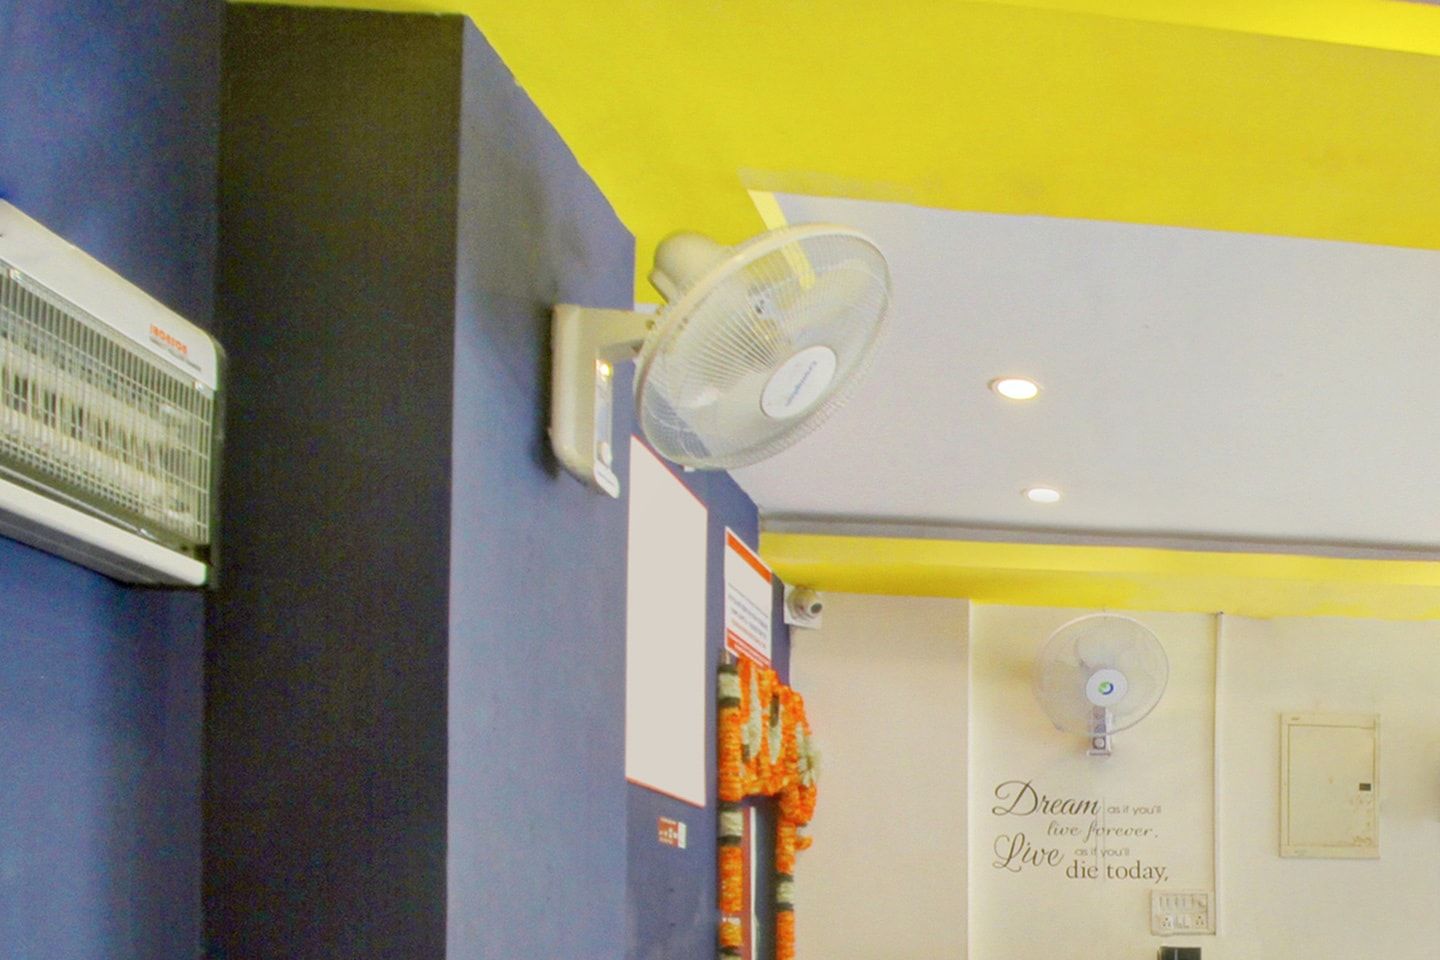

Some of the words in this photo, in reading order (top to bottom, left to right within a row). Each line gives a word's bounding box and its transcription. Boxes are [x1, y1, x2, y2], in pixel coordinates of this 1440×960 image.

[991, 779, 1100, 817] Dream
[1106, 804, 1120, 815] as
[1122, 803, 1129, 815] if
[1047, 819, 1082, 837] live
[991, 832, 1065, 873] Live
[1074, 848, 1088, 857] as
[1090, 846, 1097, 857] if
[1065, 860, 1099, 880] die
